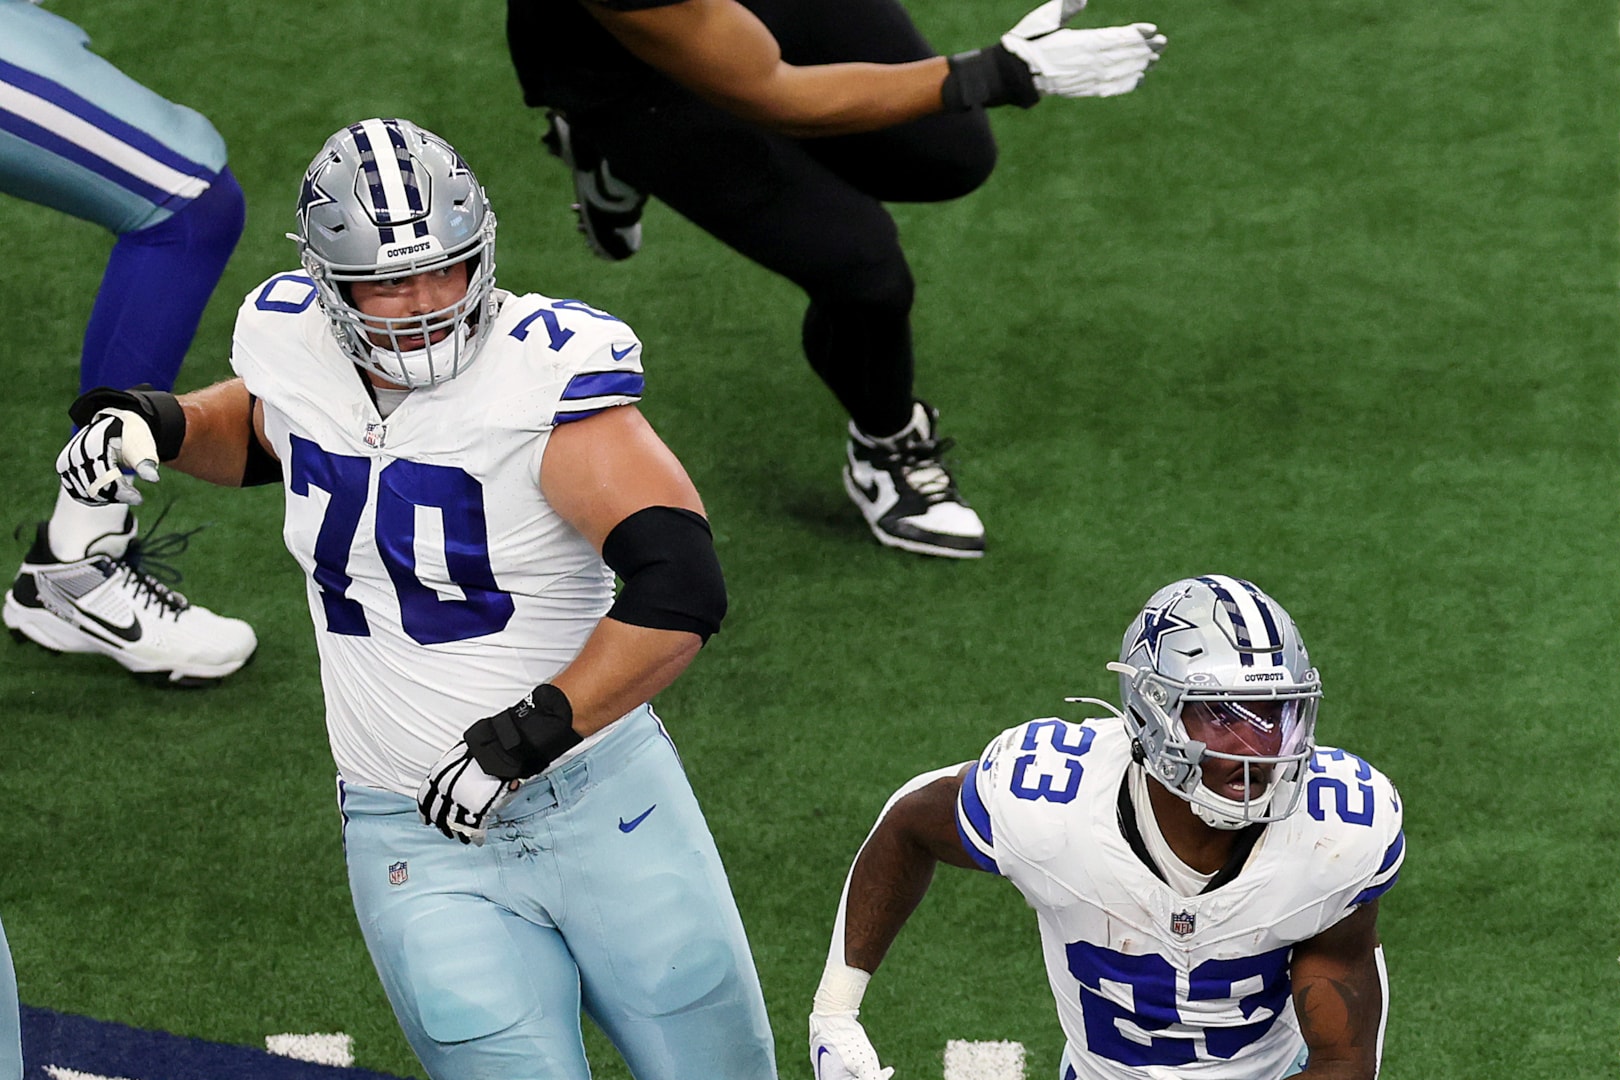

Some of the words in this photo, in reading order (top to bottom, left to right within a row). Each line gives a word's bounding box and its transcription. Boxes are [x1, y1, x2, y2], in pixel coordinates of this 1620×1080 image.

[387, 241, 431, 258] COWBOYS
[254, 274, 319, 314] 0
[289, 432, 516, 646] 70
[1244, 672, 1285, 682] COWBOYS
[1009, 719, 1097, 805] 23
[1307, 748, 1375, 828] 23
[1174, 921, 1194, 934] NFL
[1065, 939, 1294, 1067] 23
